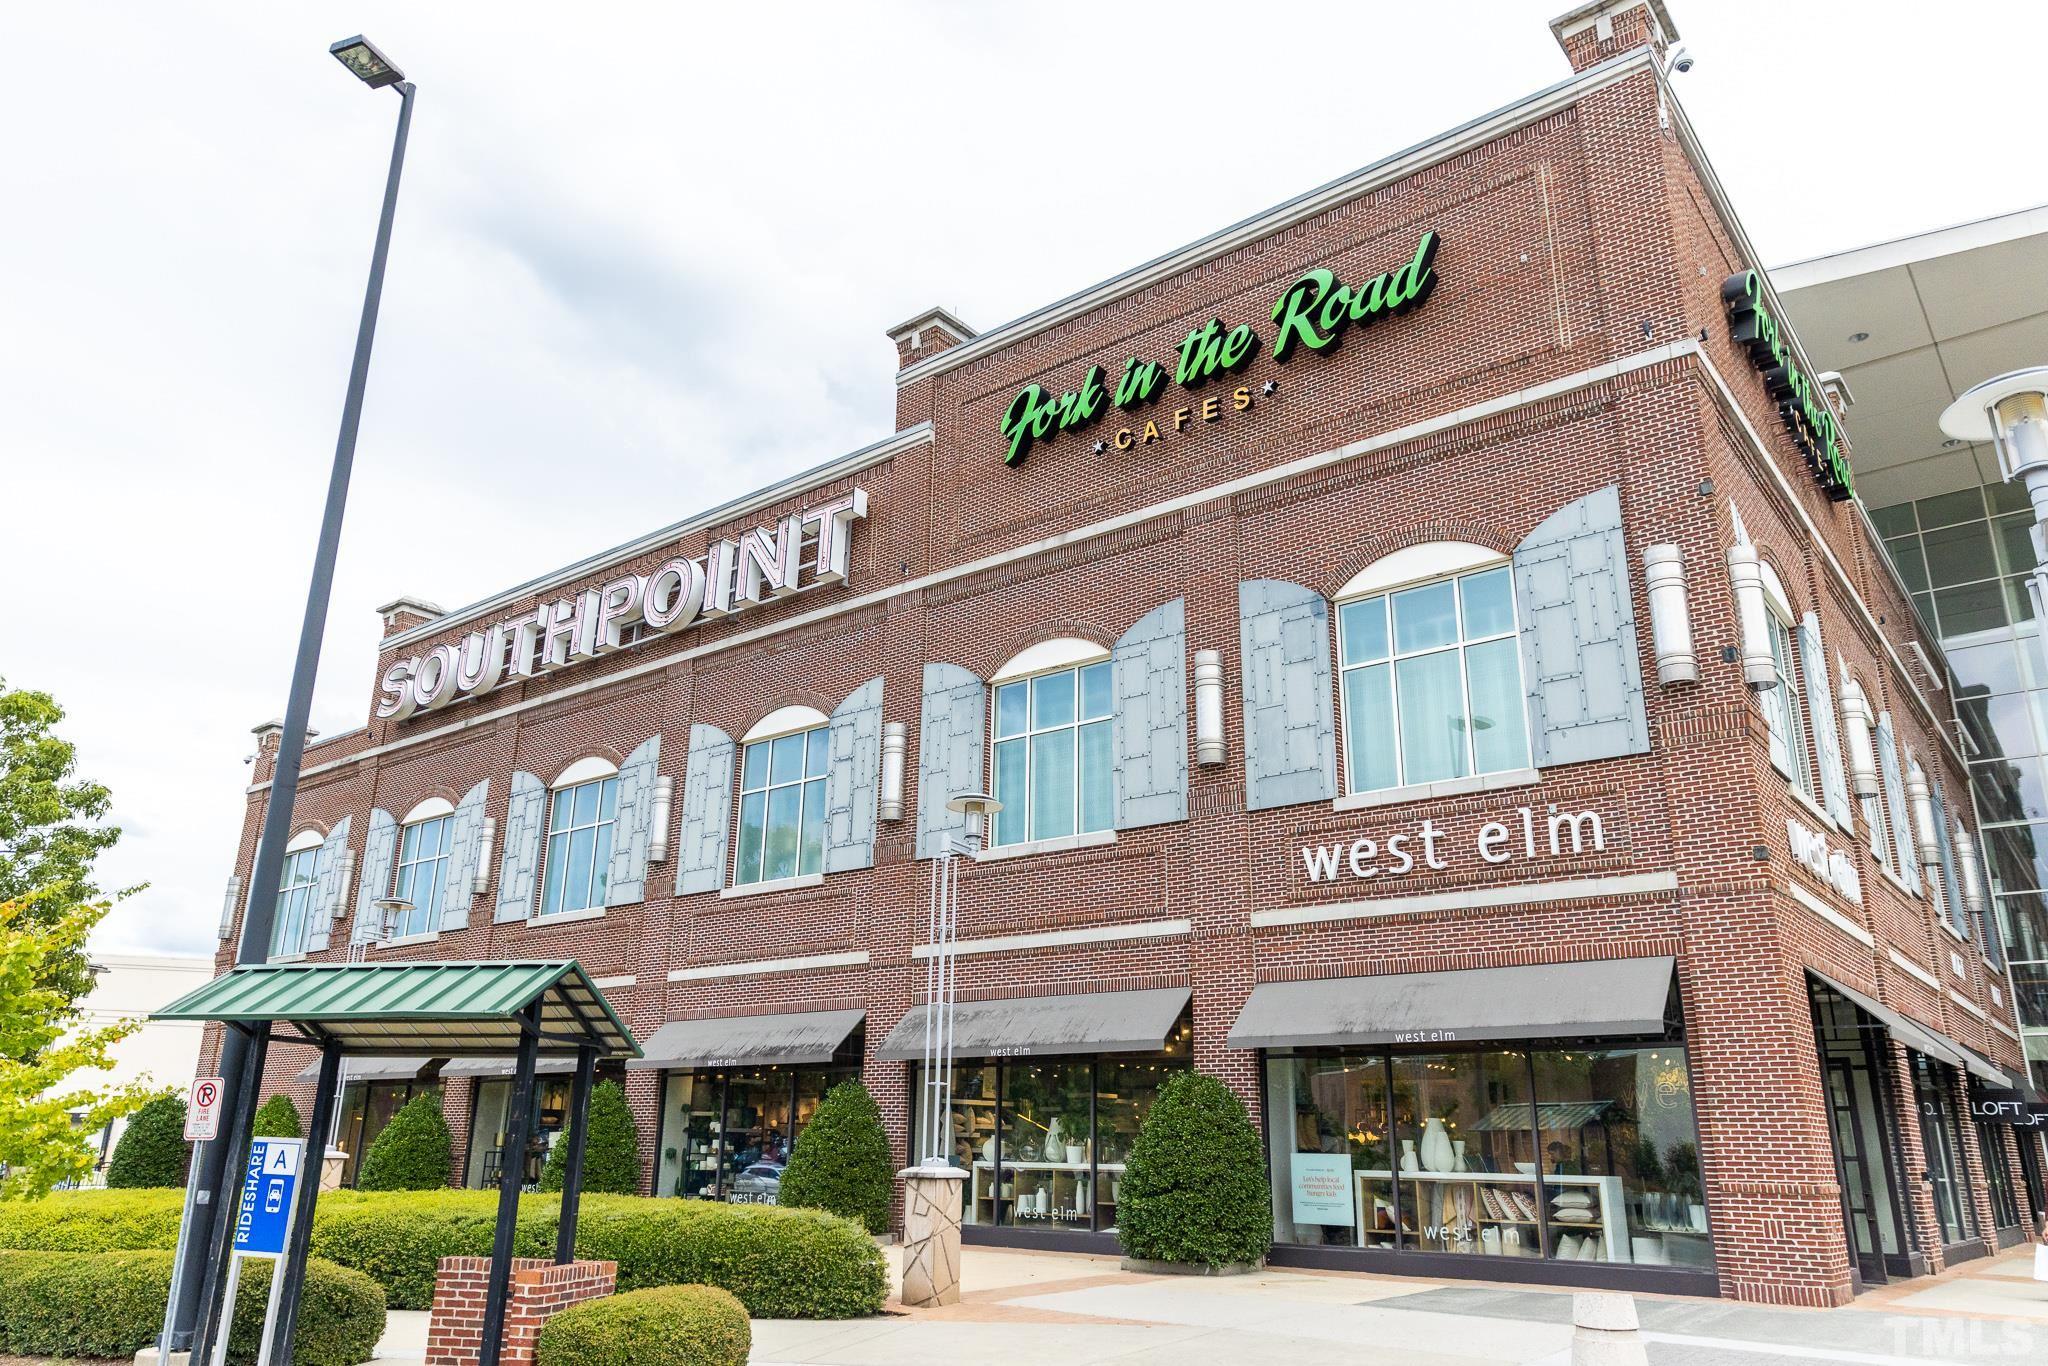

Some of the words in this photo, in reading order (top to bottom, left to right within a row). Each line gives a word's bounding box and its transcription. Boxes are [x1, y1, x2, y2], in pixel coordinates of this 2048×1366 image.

[999, 364, 1107, 468] Fork
[1114, 357, 1168, 409] in
[1174, 317, 1257, 388] the
[1270, 230, 1439, 361] Road
[1114, 386, 1252, 450] CAFES
[376, 487, 868, 722] SOUTHPOINT
[1302, 819, 1448, 882] west
[1477, 807, 1606, 864] elm
[1395, 1030, 1426, 1043] west
[1431, 1029, 1456, 1042] elm
[990, 1047, 1011, 1057] west
[1014, 1046, 1031, 1056] elm
[707, 1058, 723, 1067] west
[724, 1058, 737, 1067] elm
[1971, 1101, 2023, 1116] LOFT
[273, 1149, 287, 1169] A
[236, 1145, 265, 1243] RIDESHARE
[730, 1191, 753, 1204] west
[757, 1192, 776, 1206] elm
[1013, 1204, 1046, 1219] west
[1051, 1205, 1077, 1221] elm
[1423, 1223, 1472, 1242] west
[1481, 1225, 1520, 1245] elm
